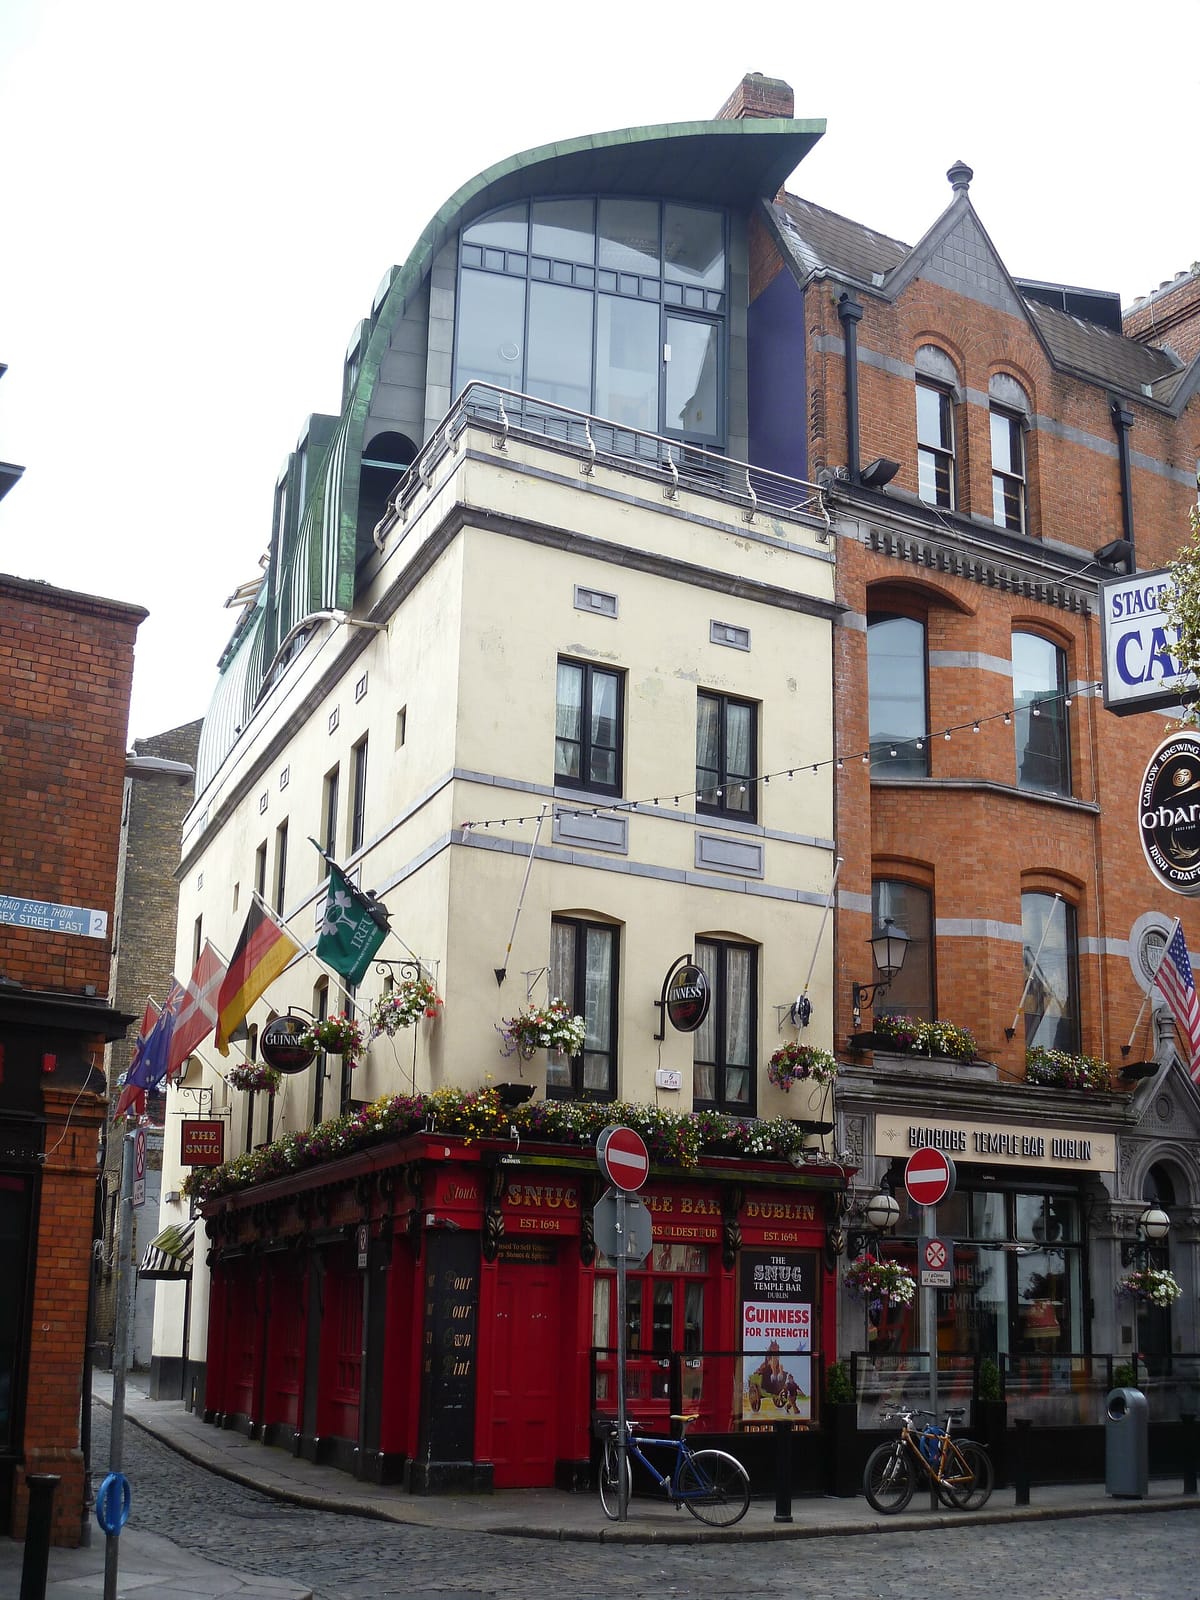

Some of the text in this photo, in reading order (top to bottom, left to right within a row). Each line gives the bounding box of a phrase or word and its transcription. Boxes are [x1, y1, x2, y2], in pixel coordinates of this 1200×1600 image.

[1116, 623, 1190, 686] CA
[1143, 743, 1199, 807] CARLOW BREWING
[1149, 844, 1169, 872] IRISH
[23, 903, 49, 915] ESSEX
[51, 908, 73, 919] THOIR
[19, 914, 55, 928] STREET
[59, 920, 84, 932] EAST
[94, 918, 103, 932] 2
[189, 1131, 216, 1140] THE
[908, 1126, 1092, 1161] BADBOBS TEMPLE BAR DUBLIN
[186, 1144, 219, 1154] SNUG
[508, 1184, 577, 1208] SNUG
[680, 1198, 721, 1216] BAR
[746, 1202, 815, 1220] DUBLIN
[520, 1219, 560, 1230] EST. 1694
[664, 1226, 697, 1237] OLDEST
[763, 1231, 798, 1241] EST. 1694
[771, 1256, 786, 1265] THE
[754, 1265, 802, 1282] SNUG
[754, 1282, 801, 1292] TEMPLE BAR
[745, 1305, 809, 1324] GUINNESS
[745, 1327, 809, 1338] FOR STRENGTH
